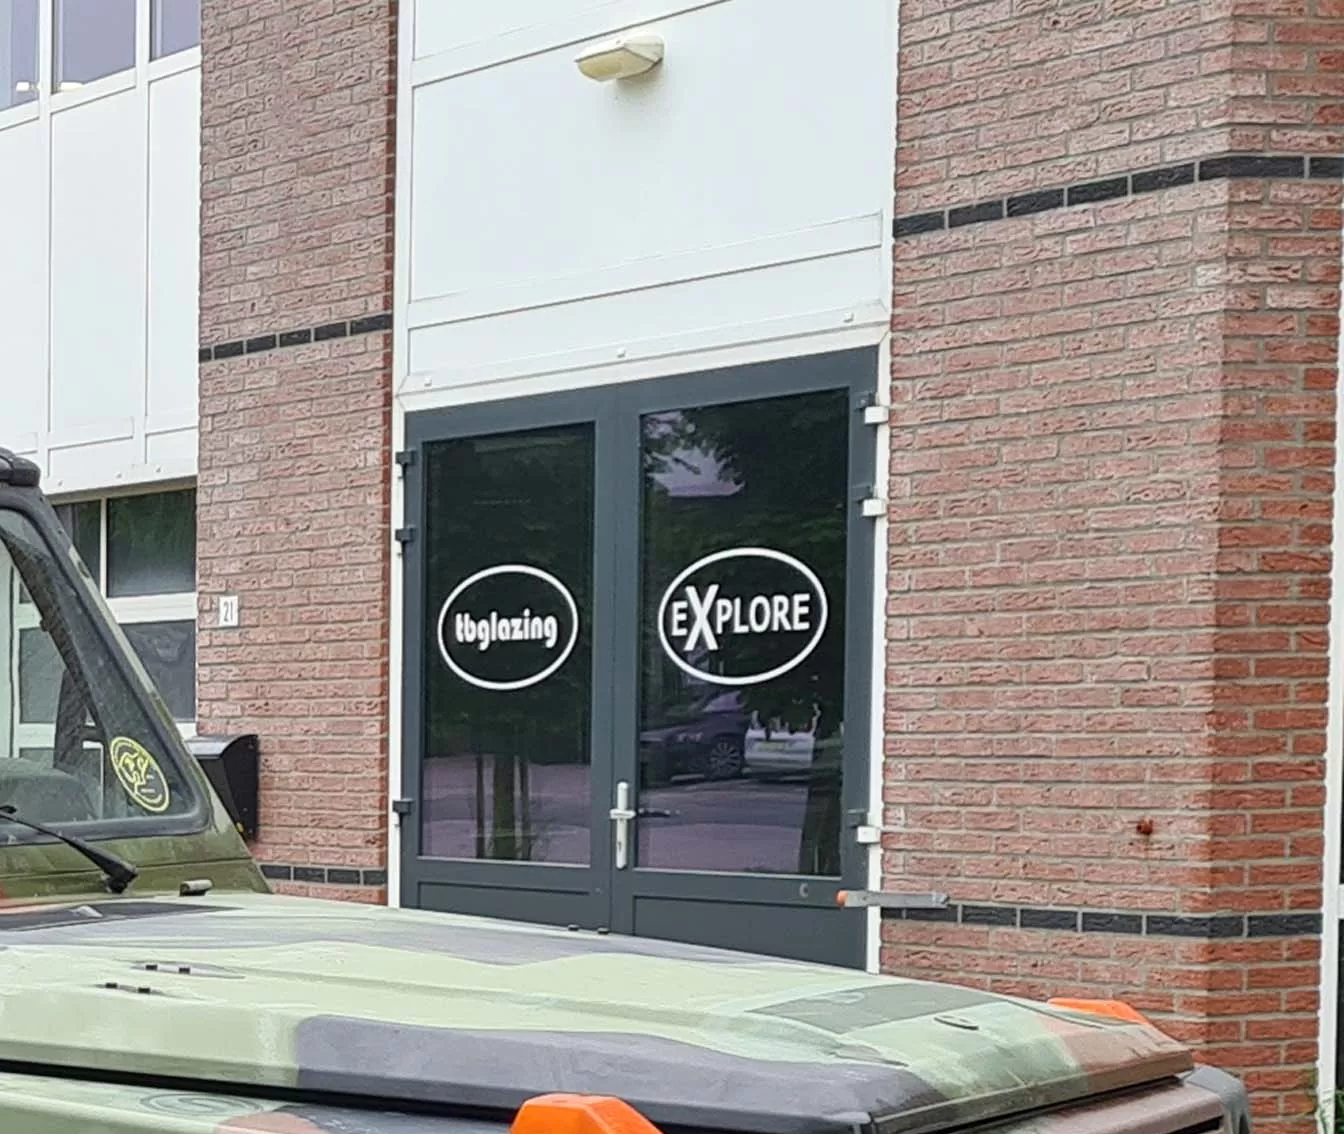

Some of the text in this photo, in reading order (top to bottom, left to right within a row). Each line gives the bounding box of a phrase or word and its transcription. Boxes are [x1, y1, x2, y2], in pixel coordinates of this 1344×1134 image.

[223, 600, 233, 622] 21
[455, 608, 558, 651] tbglazing
[671, 584, 810, 651] EXPLORE
